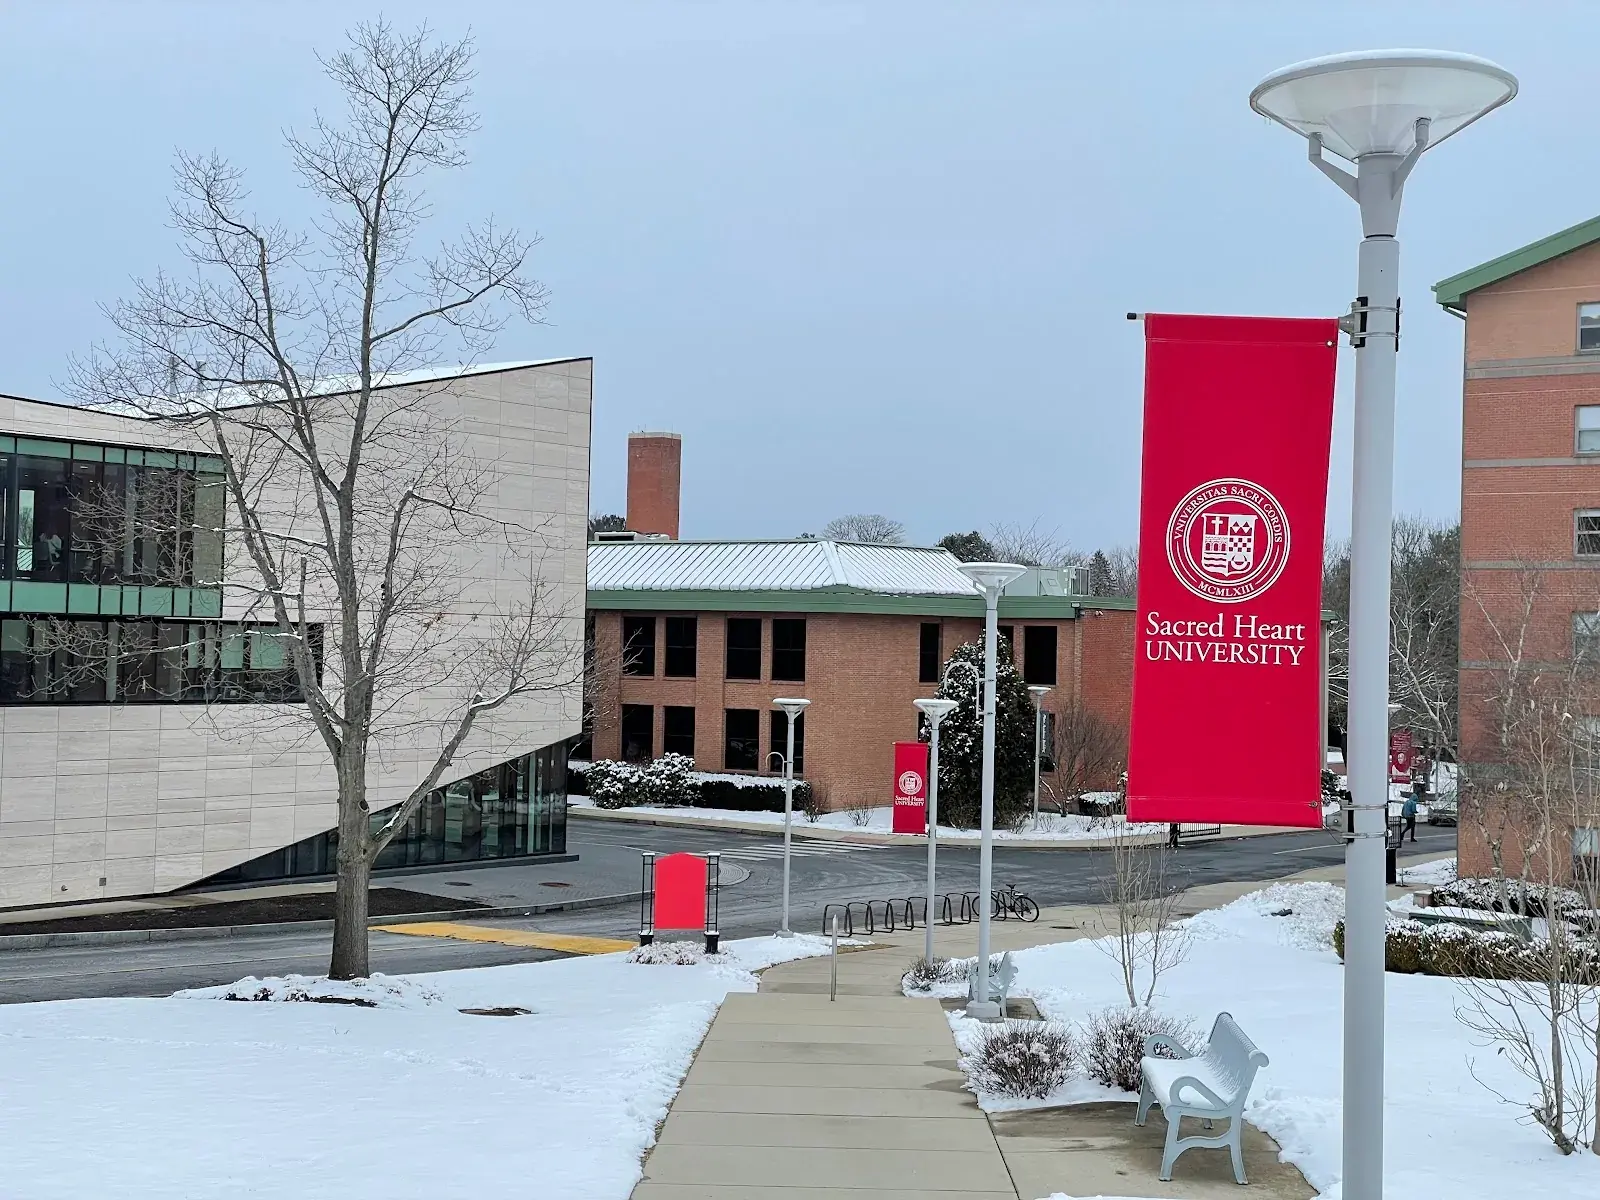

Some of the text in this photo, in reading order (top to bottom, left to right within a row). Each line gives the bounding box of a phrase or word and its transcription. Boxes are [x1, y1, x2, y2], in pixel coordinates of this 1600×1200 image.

[1230, 486, 1264, 505] SACRI
[1263, 503, 1283, 543] CORDIS
[1198, 580, 1254, 597] MCMLXIII
[1146, 611, 1306, 641] Sacred Heart
[1145, 640, 1306, 666] UNIVERSITY
